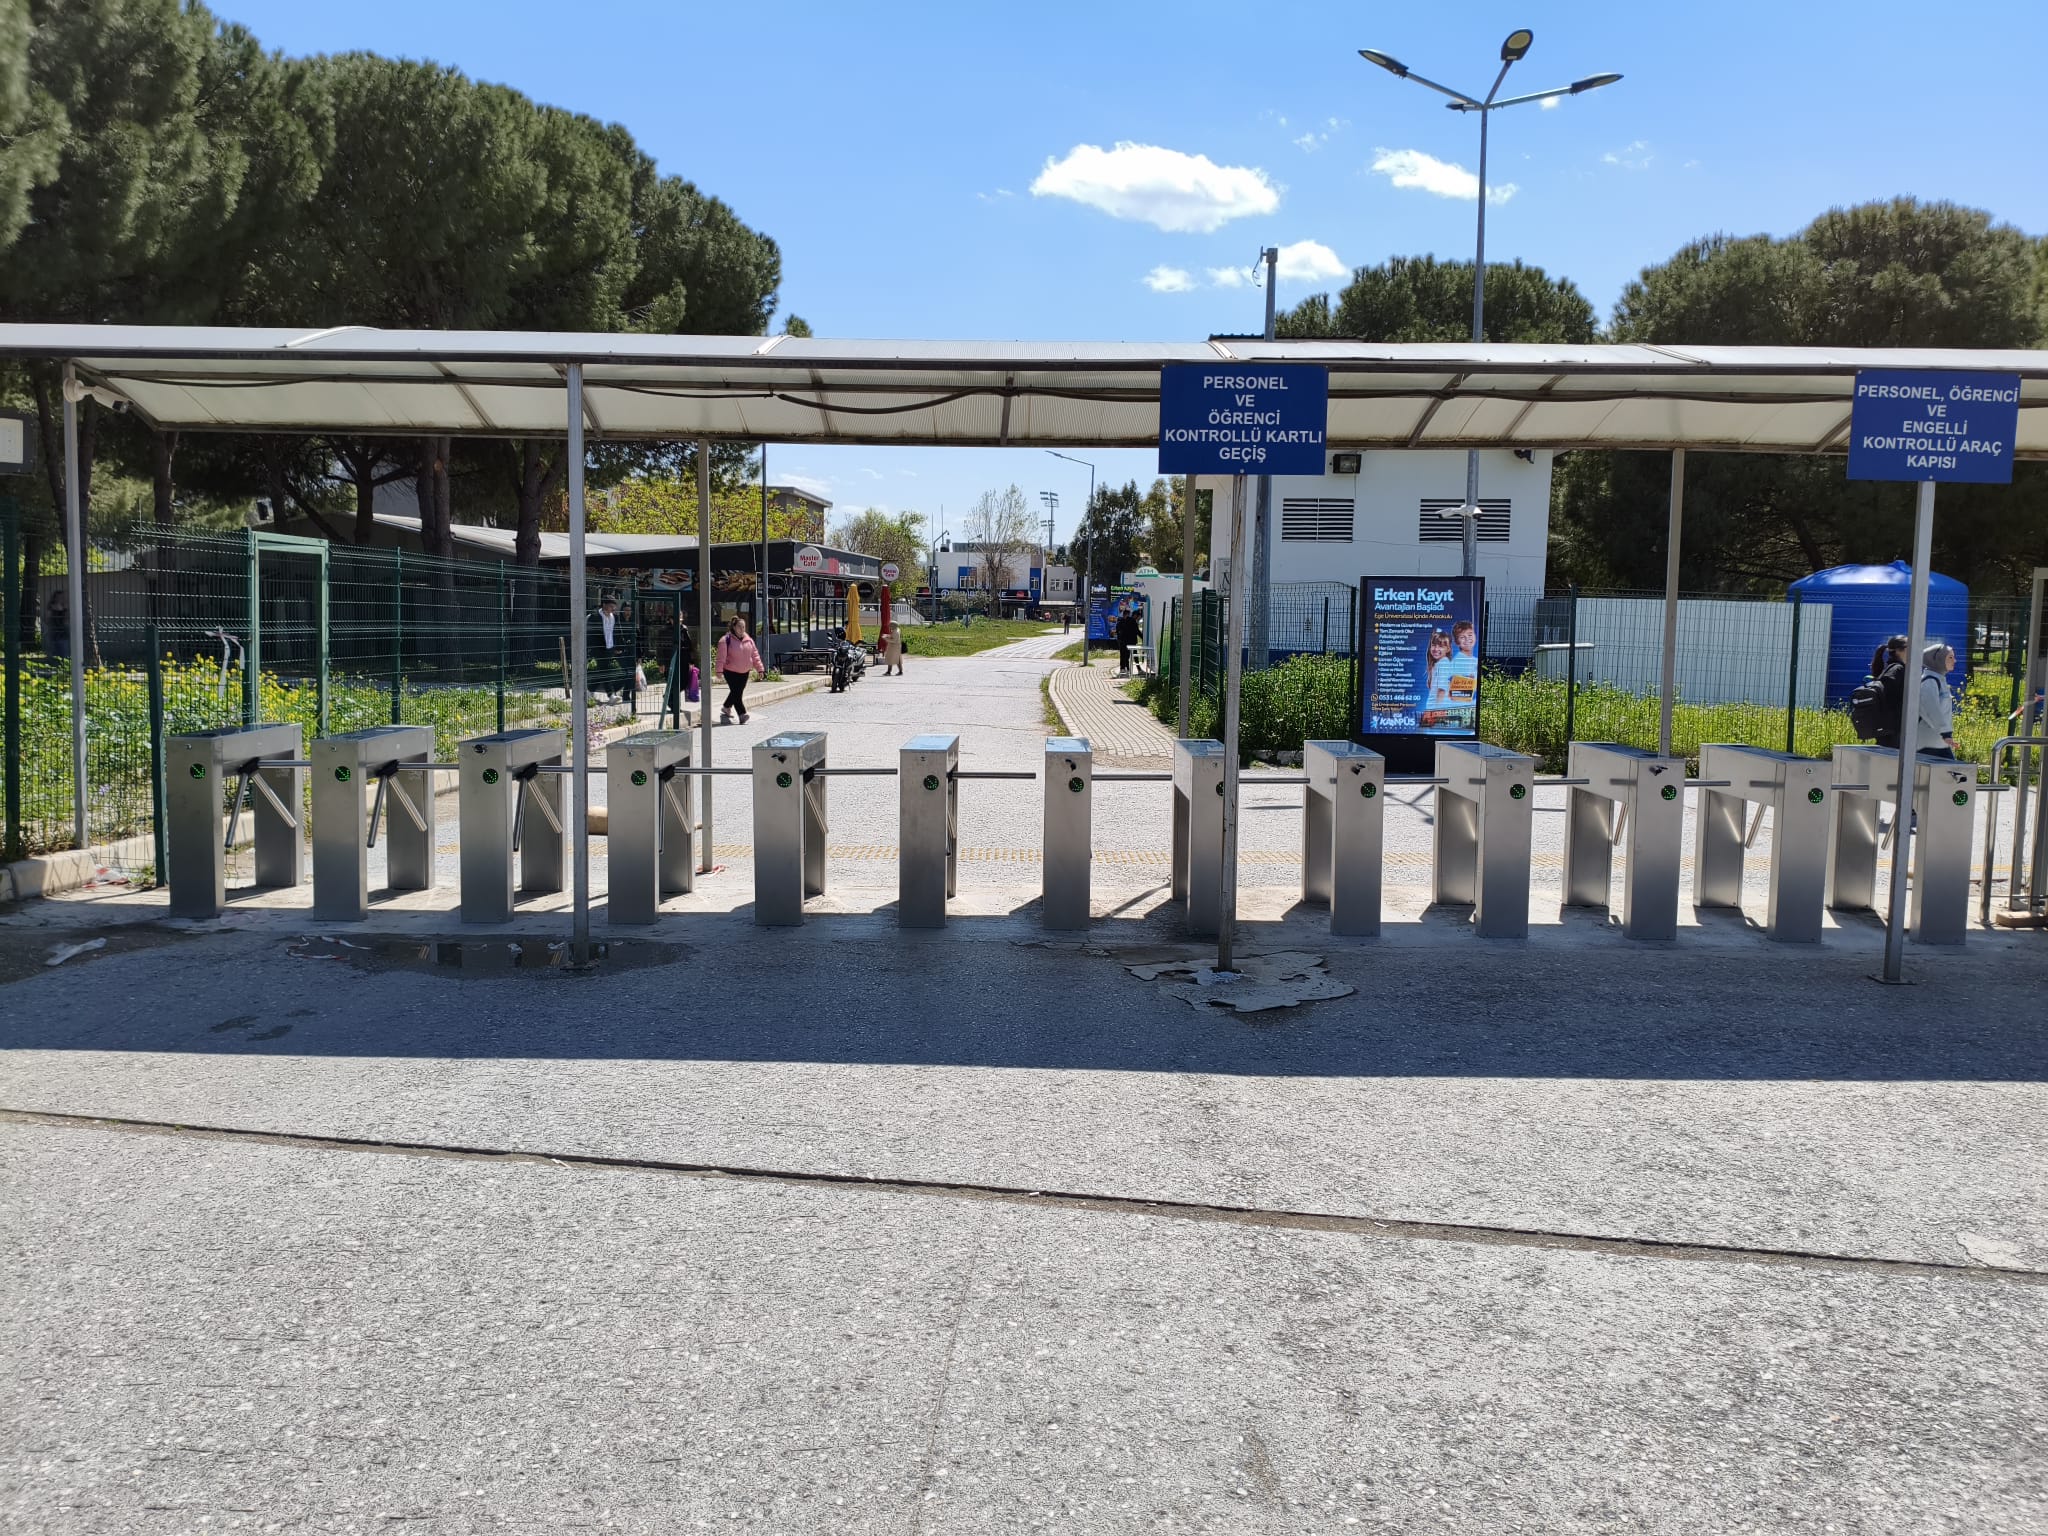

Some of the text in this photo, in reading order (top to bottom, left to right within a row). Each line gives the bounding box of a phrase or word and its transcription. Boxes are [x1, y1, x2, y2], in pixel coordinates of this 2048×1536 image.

[1203, 376, 1288, 390] PERSONEL
[1235, 394, 1255, 407] VE
[1858, 384, 2018, 402] PERSONEL, ÖĞRENCİ
[1208, 408, 1281, 425] ÖĞRENCİ
[1927, 404, 1947, 417] VE
[1165, 427, 1322, 443] KONTROLLÜ KARTLI
[1903, 420, 1967, 435] ENGELLİ
[1219, 445, 1266, 463] GEÇİŞ
[1863, 436, 2002, 457] KONTROLLÜ ARAÇ
[1906, 455, 1956, 469] KAPISI
[1374, 587, 1454, 604] Erken Kayıt
[1416, 602, 1445, 613] Başladı
